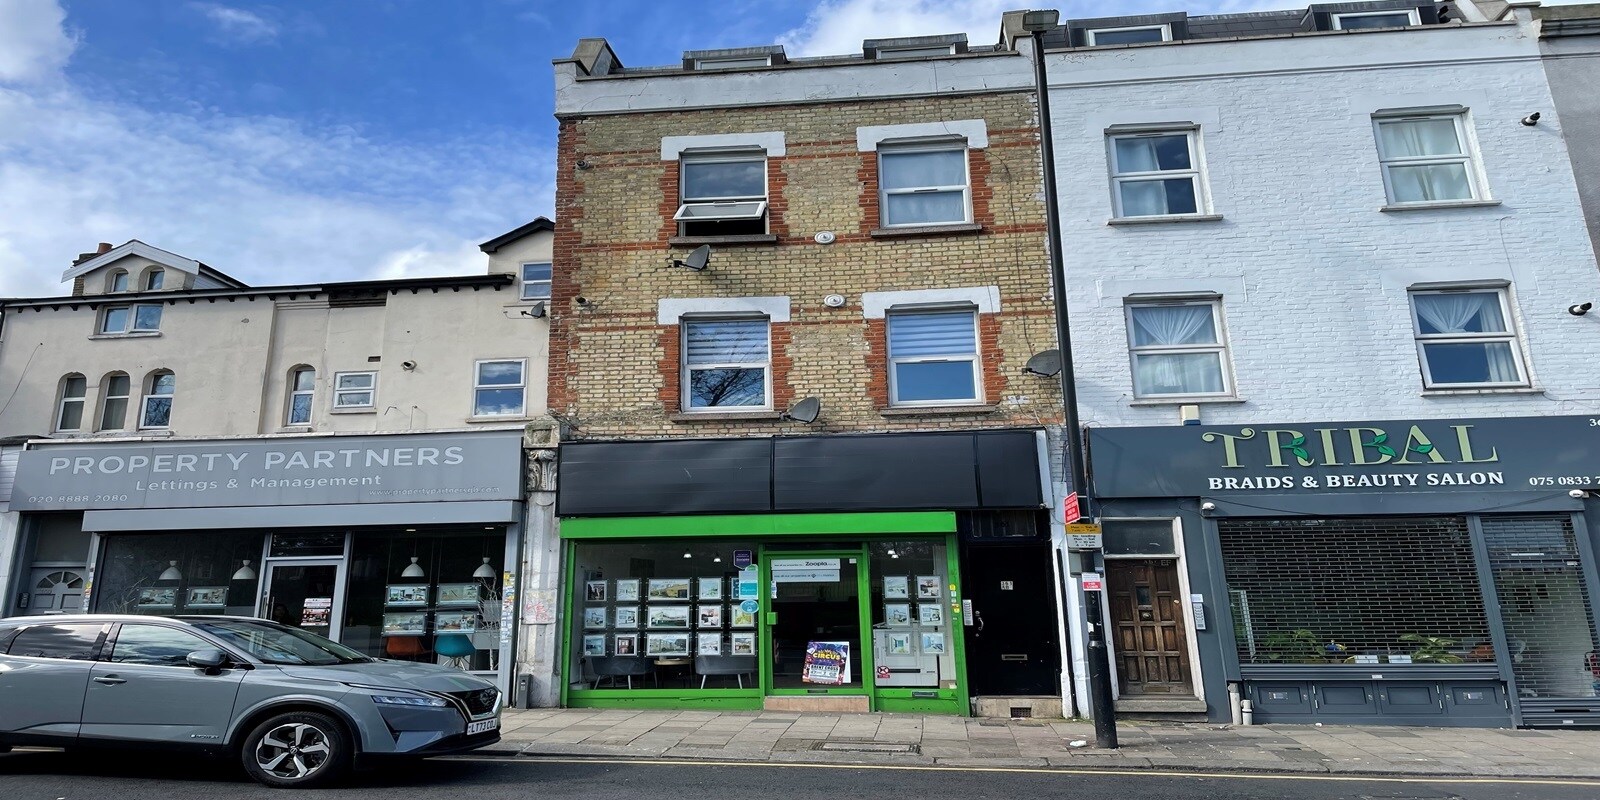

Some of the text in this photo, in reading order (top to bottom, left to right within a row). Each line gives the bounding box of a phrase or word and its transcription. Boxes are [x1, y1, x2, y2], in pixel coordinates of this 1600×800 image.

[1589, 418, 1600, 427] 3
[1202, 424, 1499, 468] TRIBAL
[49, 446, 464, 475] PROPERTY PARTNERS
[135, 474, 382, 492] Lettings & Management
[1208, 471, 1504, 490] BRAIDS & BEAUTY SALON
[1528, 476, 1555, 486] 075
[1557, 475, 1591, 486] 0833
[28, 494, 128, 504] 020 8888 2080
[812, 652, 841, 661] CIRCUS
